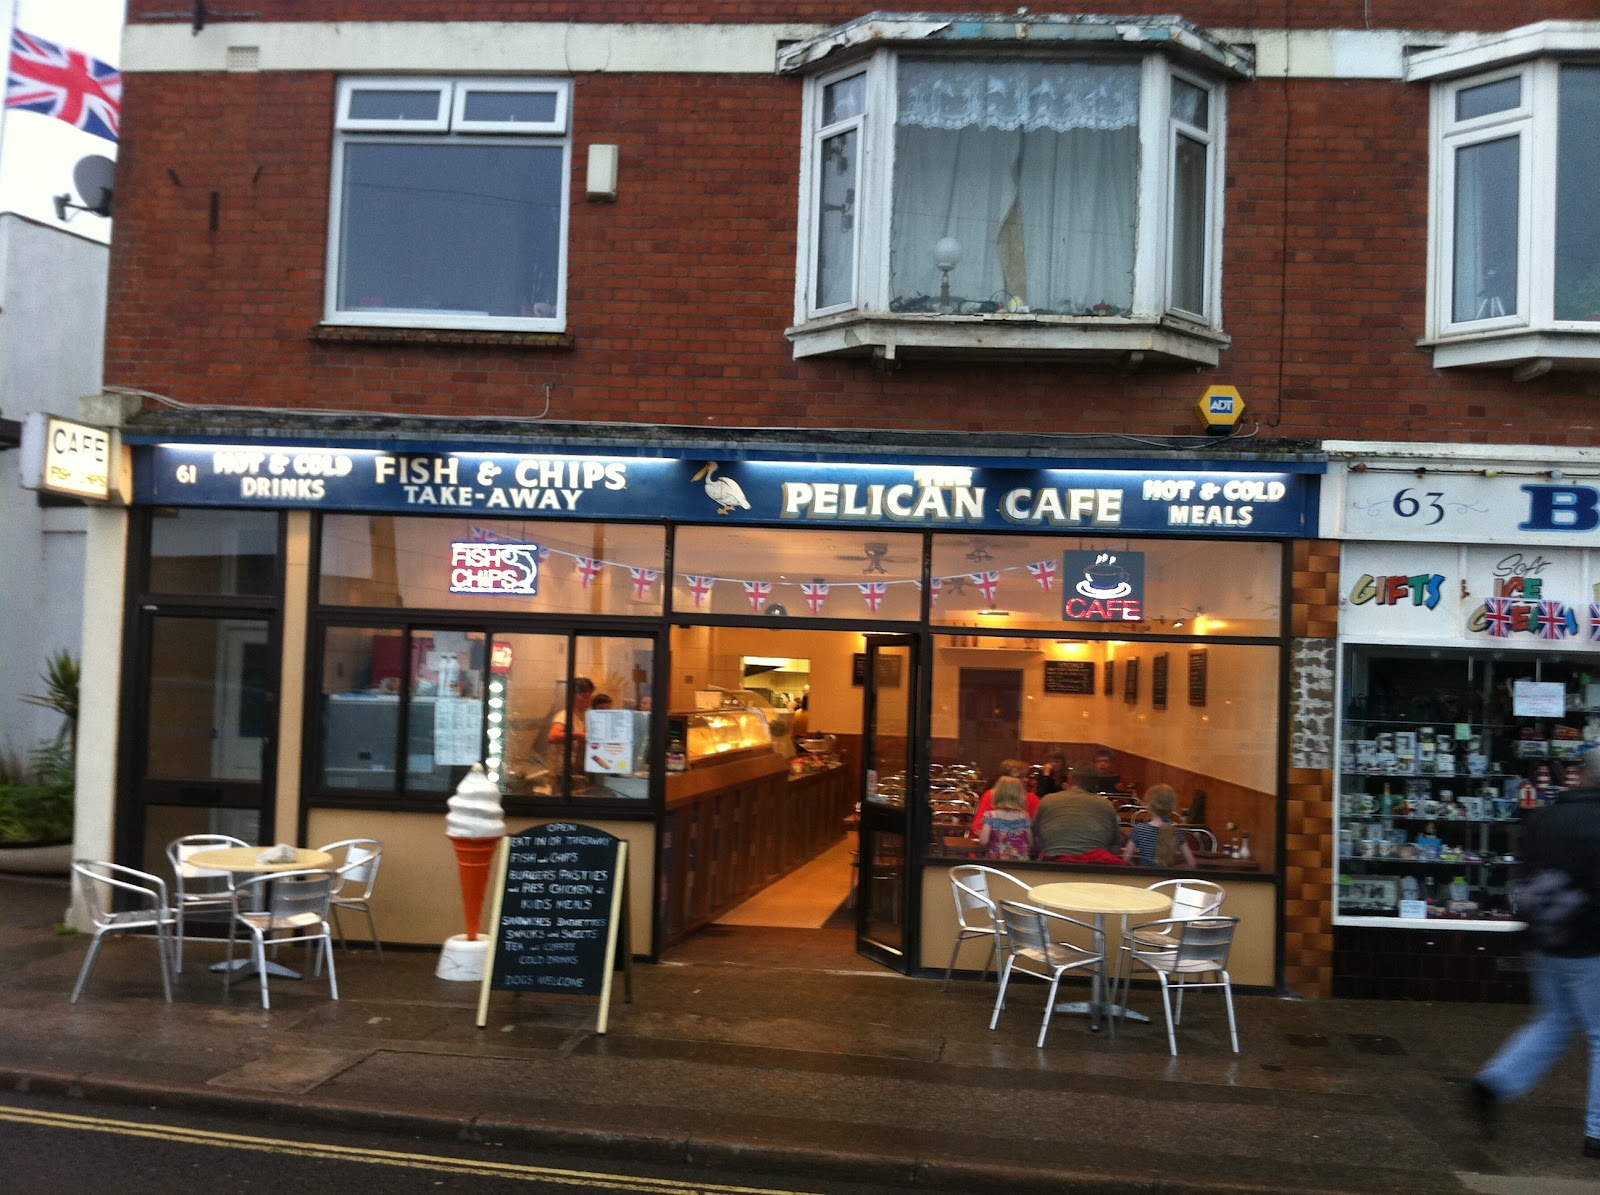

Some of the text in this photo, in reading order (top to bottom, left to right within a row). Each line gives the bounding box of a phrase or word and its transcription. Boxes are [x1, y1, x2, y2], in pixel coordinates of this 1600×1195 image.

[1210, 400, 1233, 410] ADT
[53, 428, 105, 463] CAFE
[176, 464, 197, 484] 61
[213, 451, 353, 477] HOT & COLD
[375, 456, 627, 491] FISH & CHIPS
[914, 467, 973, 487] THE
[241, 476, 326, 500] DRINKS
[1142, 479, 1286, 503] HOT & COLD
[404, 486, 584, 511] TAKE-AWAY
[780, 482, 1124, 526] PELICAN CAFE
[1393, 488, 1445, 525] 63
[1167, 505, 1254, 528] MEALS
[452, 548, 501, 567] FISH
[1492, 553, 1552, 577] Soft
[451, 568, 518, 588] CHIPS
[1350, 573, 1446, 611] GIFTS
[1493, 576, 1543, 603] ICE
[1066, 597, 1141, 620] CAFE
[1466, 603, 1579, 637] CEA
[546, 823, 577, 832] OPEN
[511, 836, 532, 847] EAT
[534, 836, 547, 846] IN
[510, 852, 537, 863] FISH
[549, 852, 579, 863] CHIPS
[509, 870, 557, 880] BURGERS
[548, 883, 594, 894] CHICKEN
[520, 899, 592, 910] KIDS MEALS
[560, 929, 598, 939] SWEETS
[504, 940, 524, 951] TEA
[543, 942, 576, 951] COFFEE
[518, 955, 544, 965] COLD
[537, 975, 585, 988] WELCOME
